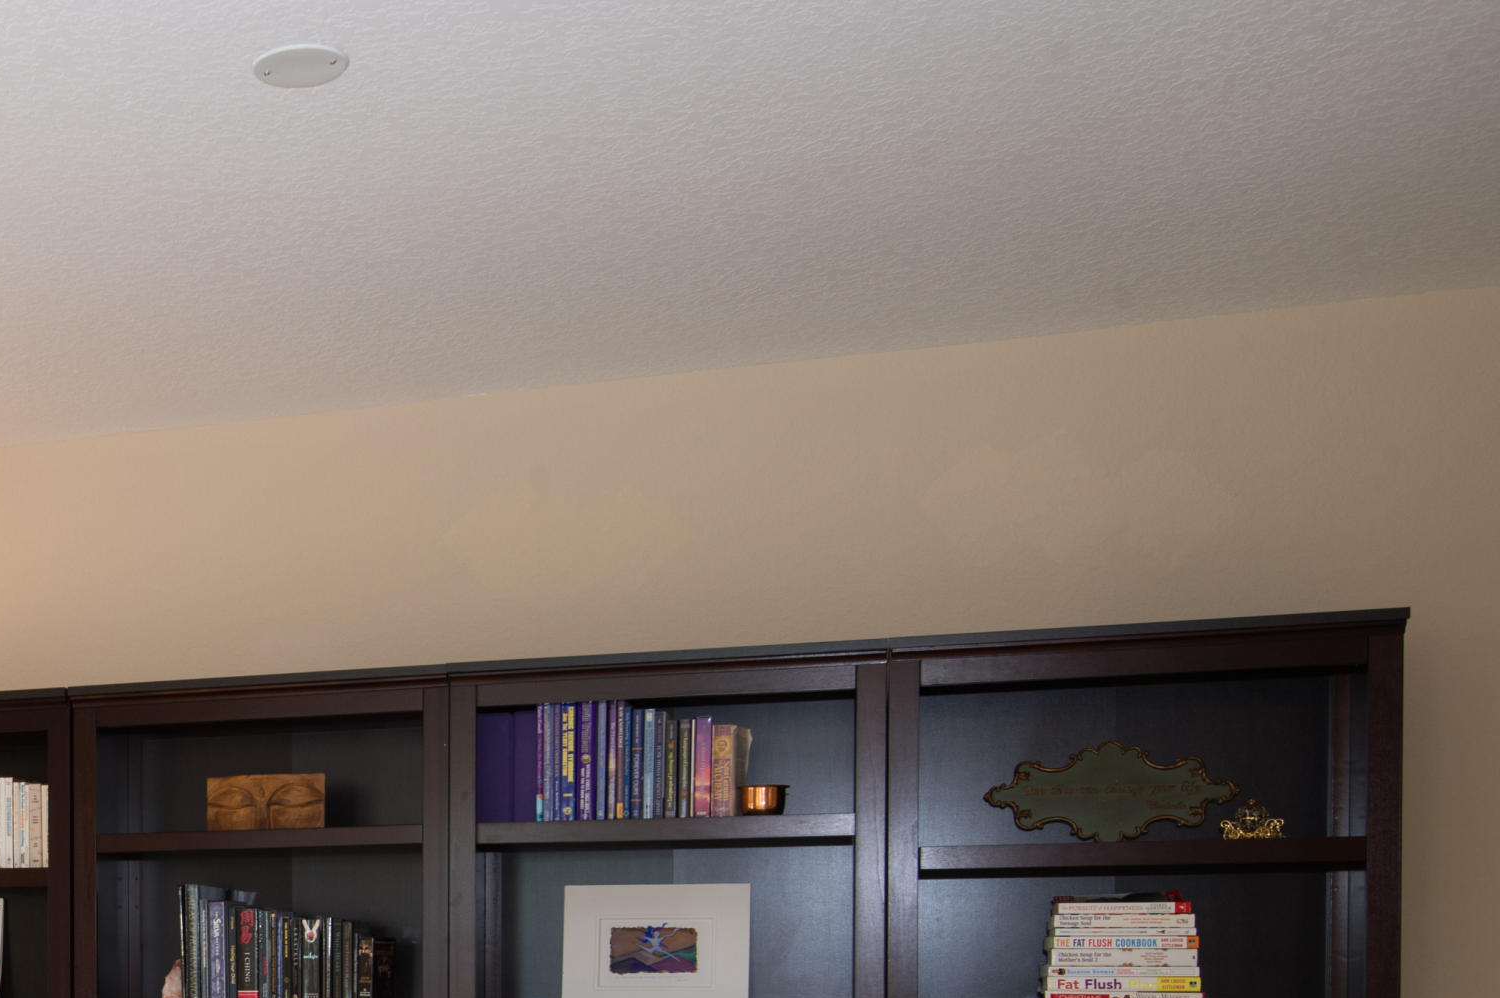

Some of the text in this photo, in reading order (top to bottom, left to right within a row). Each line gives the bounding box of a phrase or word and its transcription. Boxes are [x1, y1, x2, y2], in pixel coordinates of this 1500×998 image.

[1056, 938, 1157, 947] THE FAT FLUSH COOKBOOK
[1057, 979, 1080, 990] Fat
[1085, 979, 1122, 990] Flush
